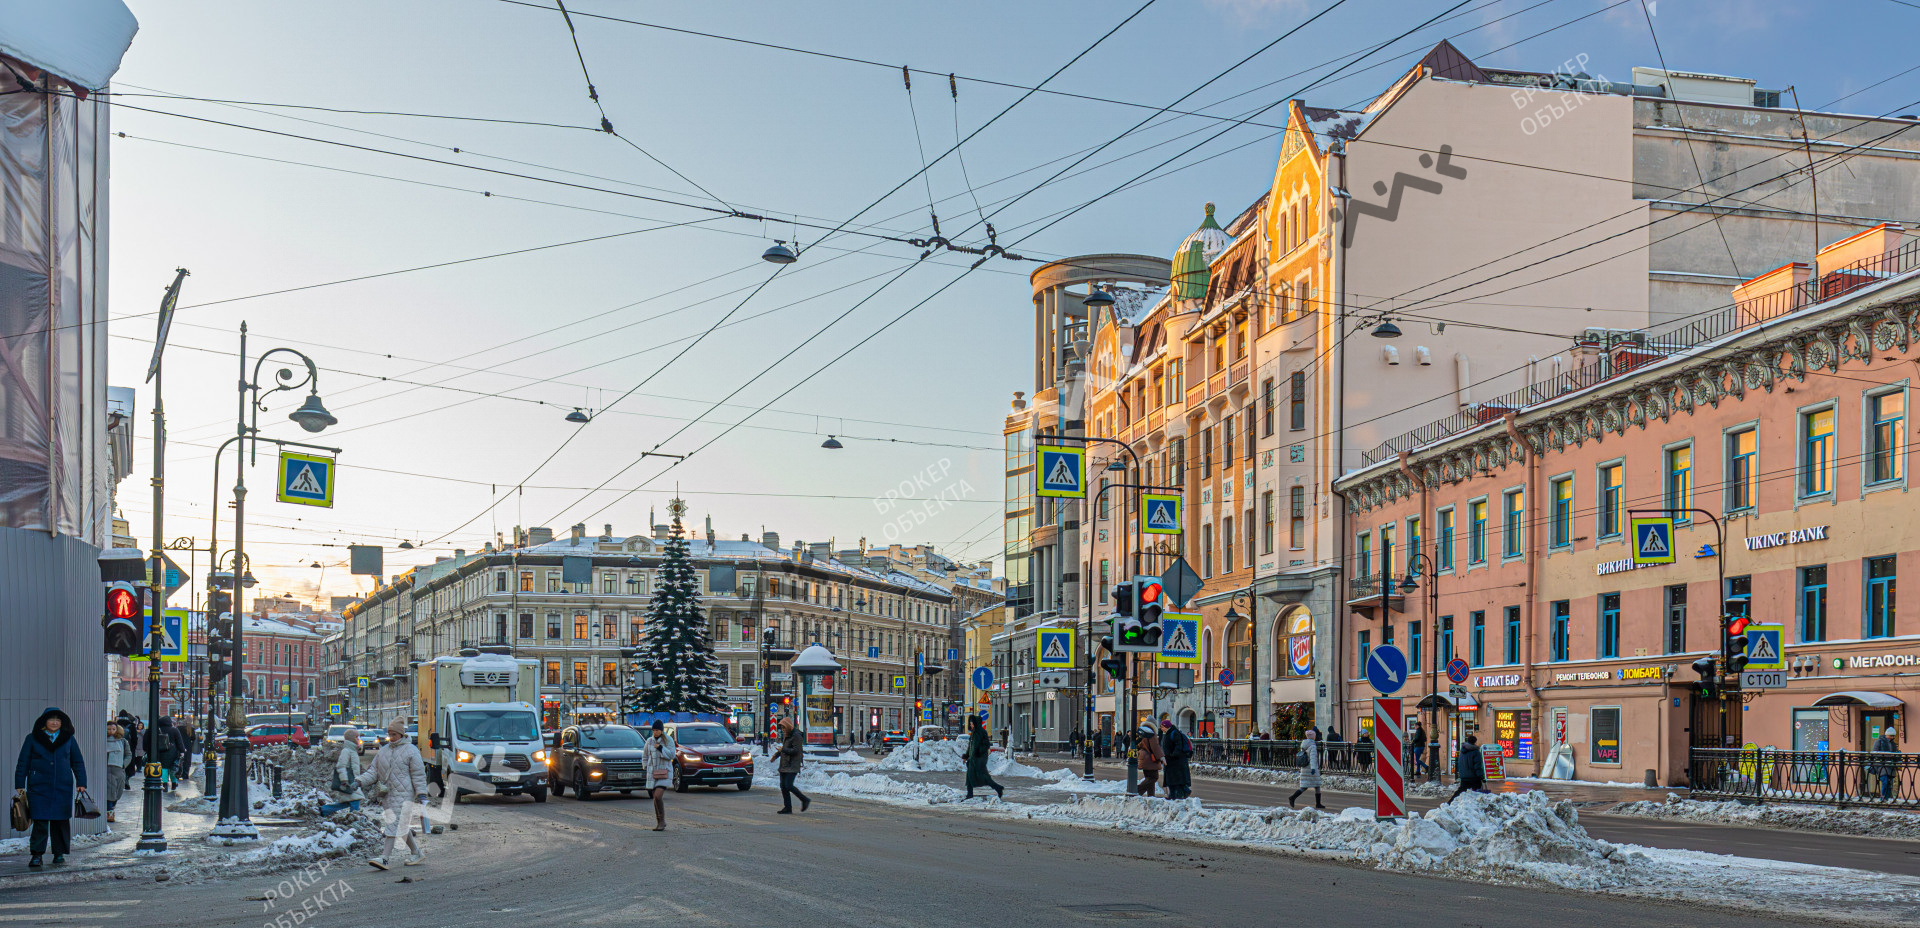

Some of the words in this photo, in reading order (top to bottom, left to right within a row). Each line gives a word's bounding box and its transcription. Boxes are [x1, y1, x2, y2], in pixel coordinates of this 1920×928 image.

[1744, 532, 1785, 551] VIKING
[1790, 525, 1826, 544] BANK
[1556, 673, 1577, 681] РЕМОНТ
[1578, 671, 1609, 680] ТЕЛЕФОНОВ
[1623, 667, 1660, 679] ЛОМБАРД
[1474, 675, 1504, 687] КОНТАКТ
[1505, 674, 1520, 686] БАР
[1747, 674, 1781, 686] СТОП
[1498, 712, 1514, 720] КИНГ
[1496, 720, 1515, 728] ТАБАК
[1497, 740, 1513, 749] VAPE
[1597, 749, 1617, 758] VAPE
